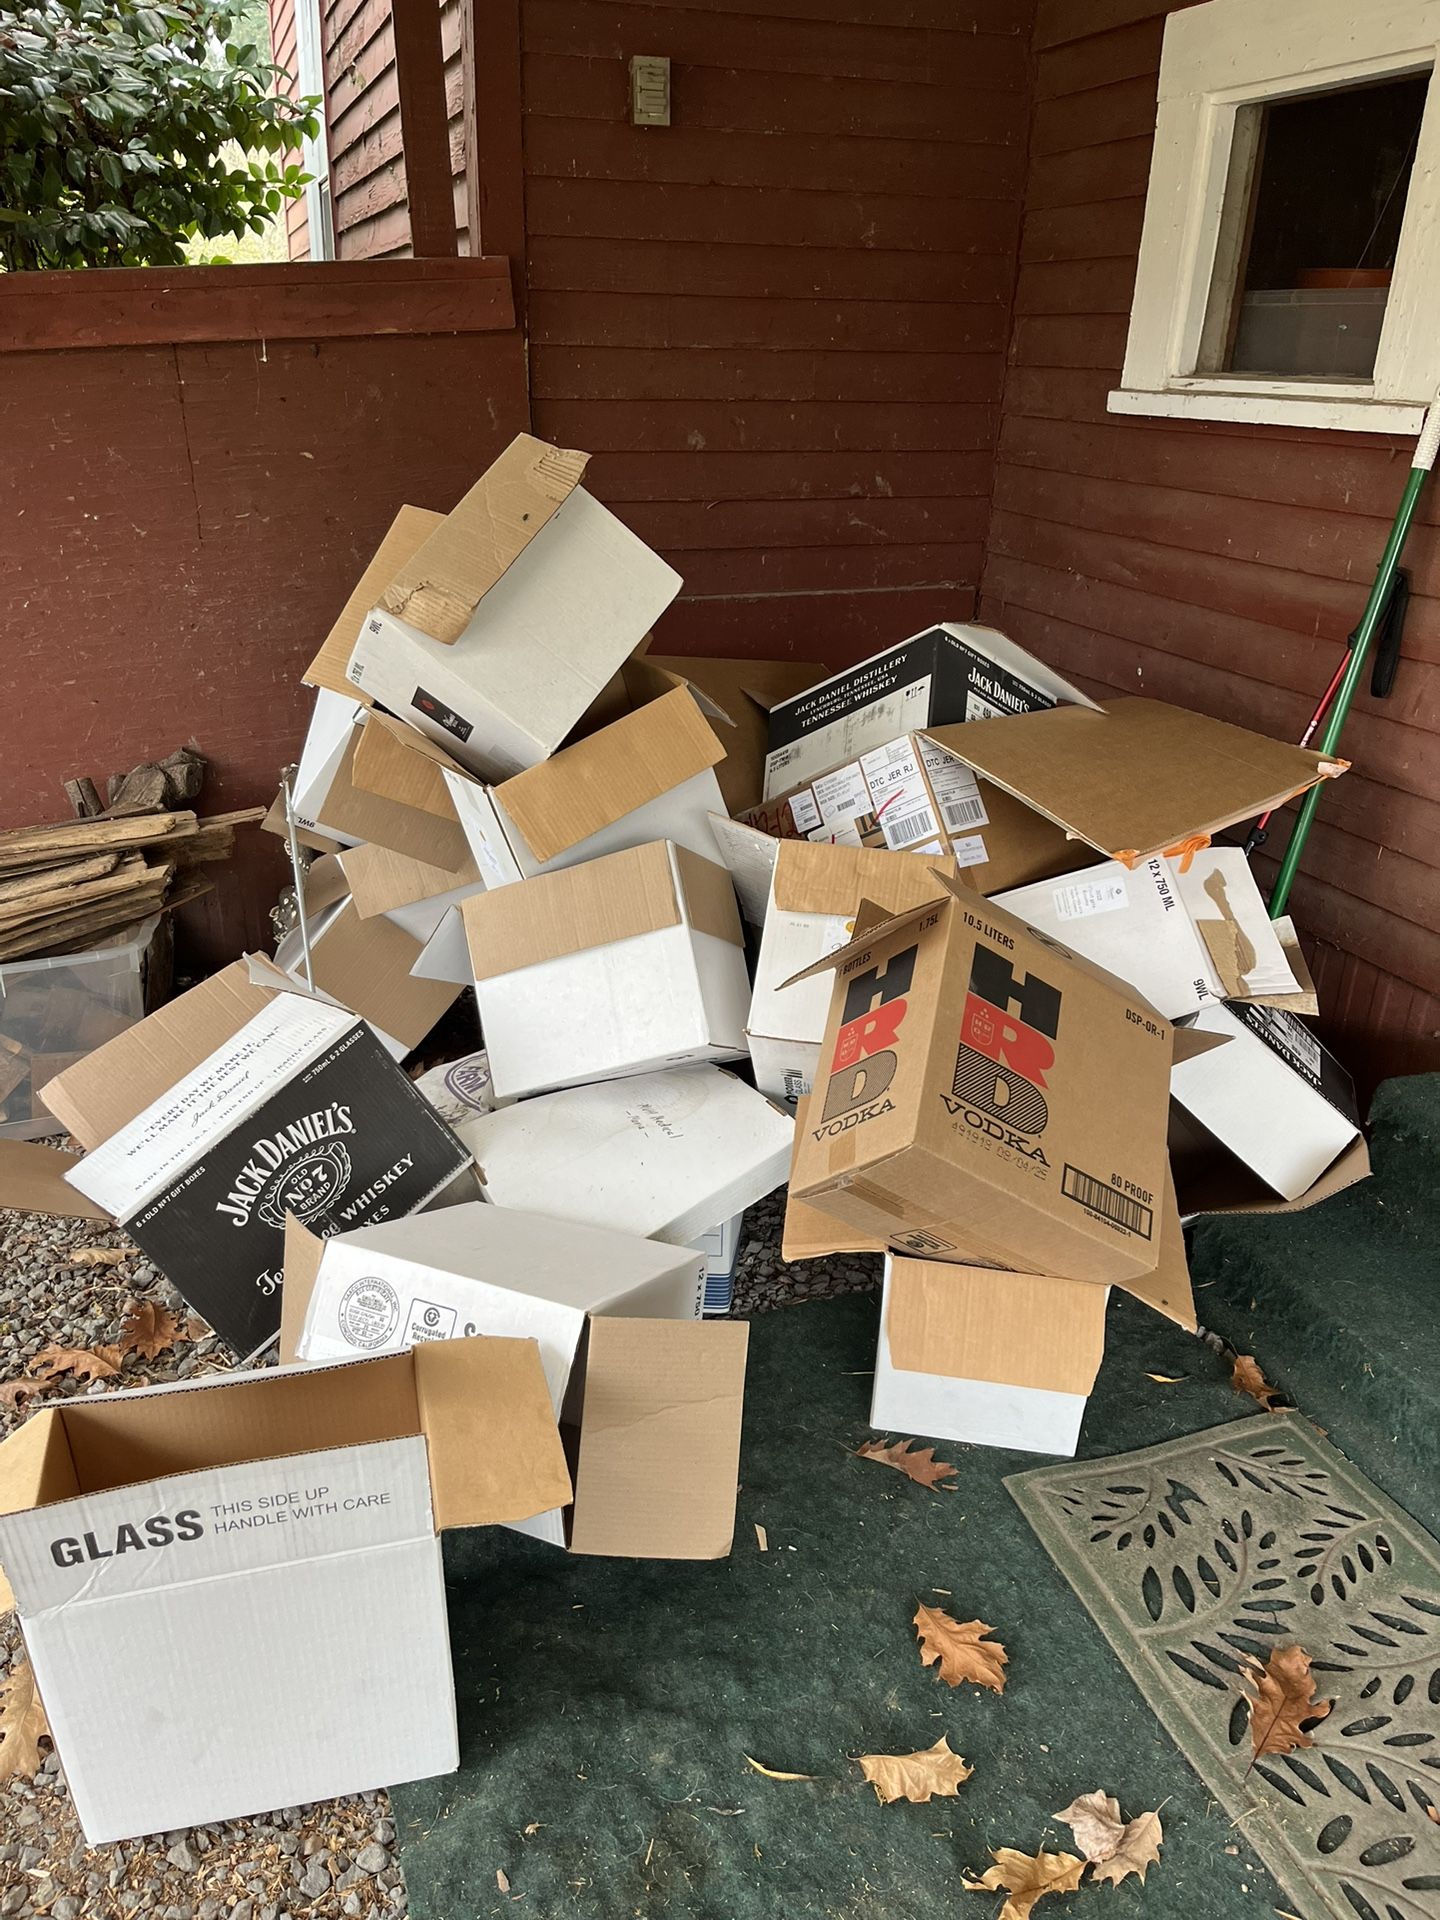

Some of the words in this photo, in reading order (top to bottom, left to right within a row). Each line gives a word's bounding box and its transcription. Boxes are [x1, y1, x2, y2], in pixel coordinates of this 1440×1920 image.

[795, 696, 817, 716] JACK
[819, 682, 851, 705] DANIEL
[853, 654, 908, 687] DISTILLERY
[967, 667, 993, 694] JACK
[993, 681, 1030, 714] DANIEL'S
[801, 699, 852, 728] TENNESSEE
[853, 675, 898, 702] WHISKEY
[870, 777, 885, 790] DTC
[887, 768, 902, 782] JER
[903, 763, 914, 774] RJ
[926, 757, 940, 768] DTC
[942, 755, 955, 765] JER
[1148, 859, 1160, 871] 12
[1155, 877, 1169, 896] 750
[1161, 895, 1176, 912] ML
[919, 912, 939, 932] 1.75L
[963, 911, 983, 932] 10.5
[984, 926, 1016, 950] LITERS
[843, 952, 872, 975] BOTTLES
[1193, 978, 1209, 1001] 9WL
[1125, 1008, 1165, 1040] DSP-OR-1
[1245, 1013, 1292, 1061] DANIEL'S
[311, 1059, 331, 1075] 750mL
[335, 1049, 340, 1057] 2
[339, 1029, 365, 1053] GLASSES
[181, 1087, 200, 1105] DAY
[200, 1074, 215, 1088] WE
[215, 1051, 242, 1074] MAKE
[1291, 1056, 1323, 1086] JACK
[127, 1132, 159, 1157] WE'LL
[158, 1109, 188, 1133] MAKE
[187, 1099, 198, 1110] IT
[198, 1081, 218, 1099] THE
[217, 1062, 241, 1081] BEST
[241, 1048, 257, 1062] WE
[134, 1172, 159, 1192] MADE
[159, 1163, 170, 1173] IN
[171, 1146, 187, 1162] THE
[219, 1104, 237, 1120] THIS
[238, 1090, 254, 1104] END
[254, 1080, 265, 1091] UP
[812, 1098, 897, 1142] VODKA
[940, 1094, 1050, 1168] VODKA
[290, 1168, 308, 1185] OLD
[311, 1164, 329, 1182] 7
[340, 1152, 415, 1222] WHISKEY
[1111, 1173, 1122, 1188] 80
[1124, 1180, 1154, 1205] PROOF
[145, 1207, 159, 1221] OLD
[170, 1183, 186, 1197] GIFT
[184, 1166, 206, 1186] BOXES
[216, 1158, 273, 1228] JACK
[300, 1181, 331, 1211] BRAND
[360, 1204, 391, 1231] XES
[698, 1266, 705, 1280] 12
[694, 1294, 702, 1316] 750
[411, 1322, 447, 1340] Corrugated
[210, 1500, 253, 1517] THIS
[258, 1491, 300, 1510] SIDE
[304, 1485, 330, 1502] UP
[214, 1511, 288, 1534] HANDLE
[292, 1501, 339, 1520] WITH
[343, 1492, 391, 1511] CARE
[49, 1508, 205, 1569] GLASS
